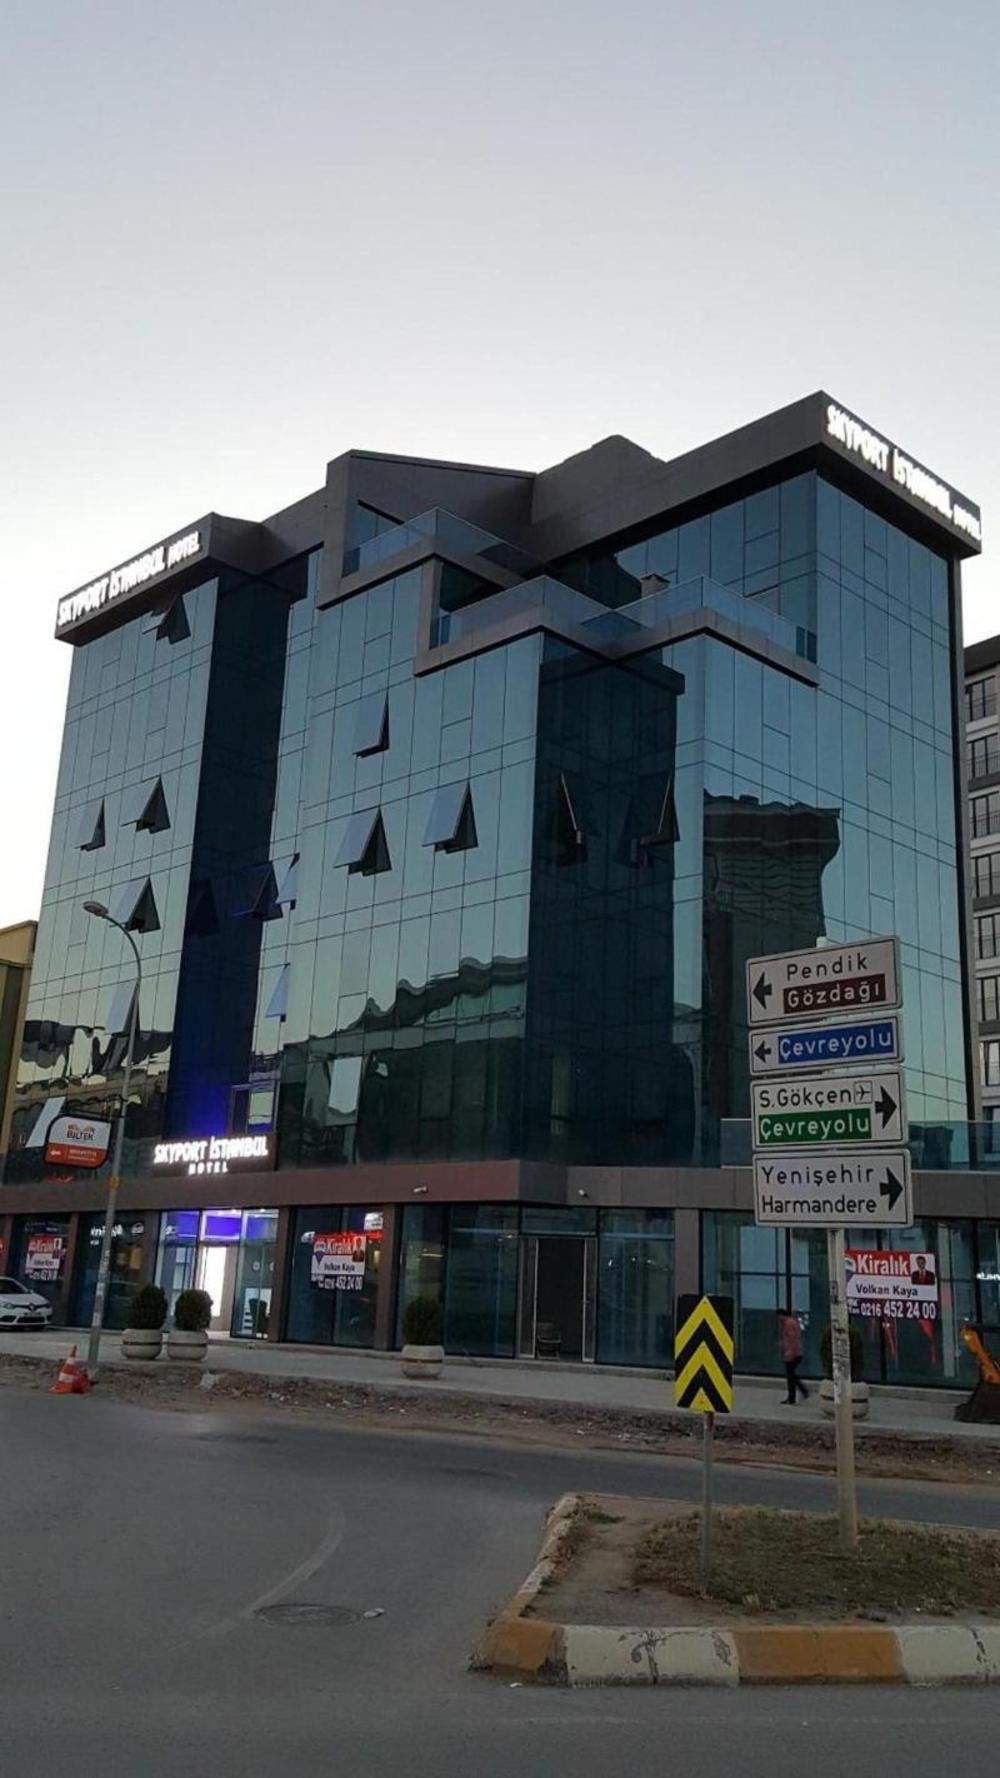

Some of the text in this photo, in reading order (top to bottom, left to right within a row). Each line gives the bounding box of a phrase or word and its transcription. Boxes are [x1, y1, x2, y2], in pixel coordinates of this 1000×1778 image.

[787, 952, 868, 981] Pendik
[787, 981, 881, 1009] Gözdağı
[778, 1029, 892, 1061] Çevreyolu
[759, 1088, 852, 1109] S.Gökçen
[759, 1114, 870, 1140] Çevreyolu
[154, 1141, 207, 1164] SKYPORT
[188, 1161, 228, 1175] HOTEL
[761, 1165, 875, 1187] Yenişehir
[761, 1195, 878, 1214] Harmandere
[857, 1254, 910, 1275] Kiralık
[856, 1283, 918, 1298] Volkan Kaya
[860, 1302, 881, 1316] 0216
[884, 1300, 904, 1318] 452
[906, 1301, 920, 1319] 24
[922, 1302, 936, 1319] 00
